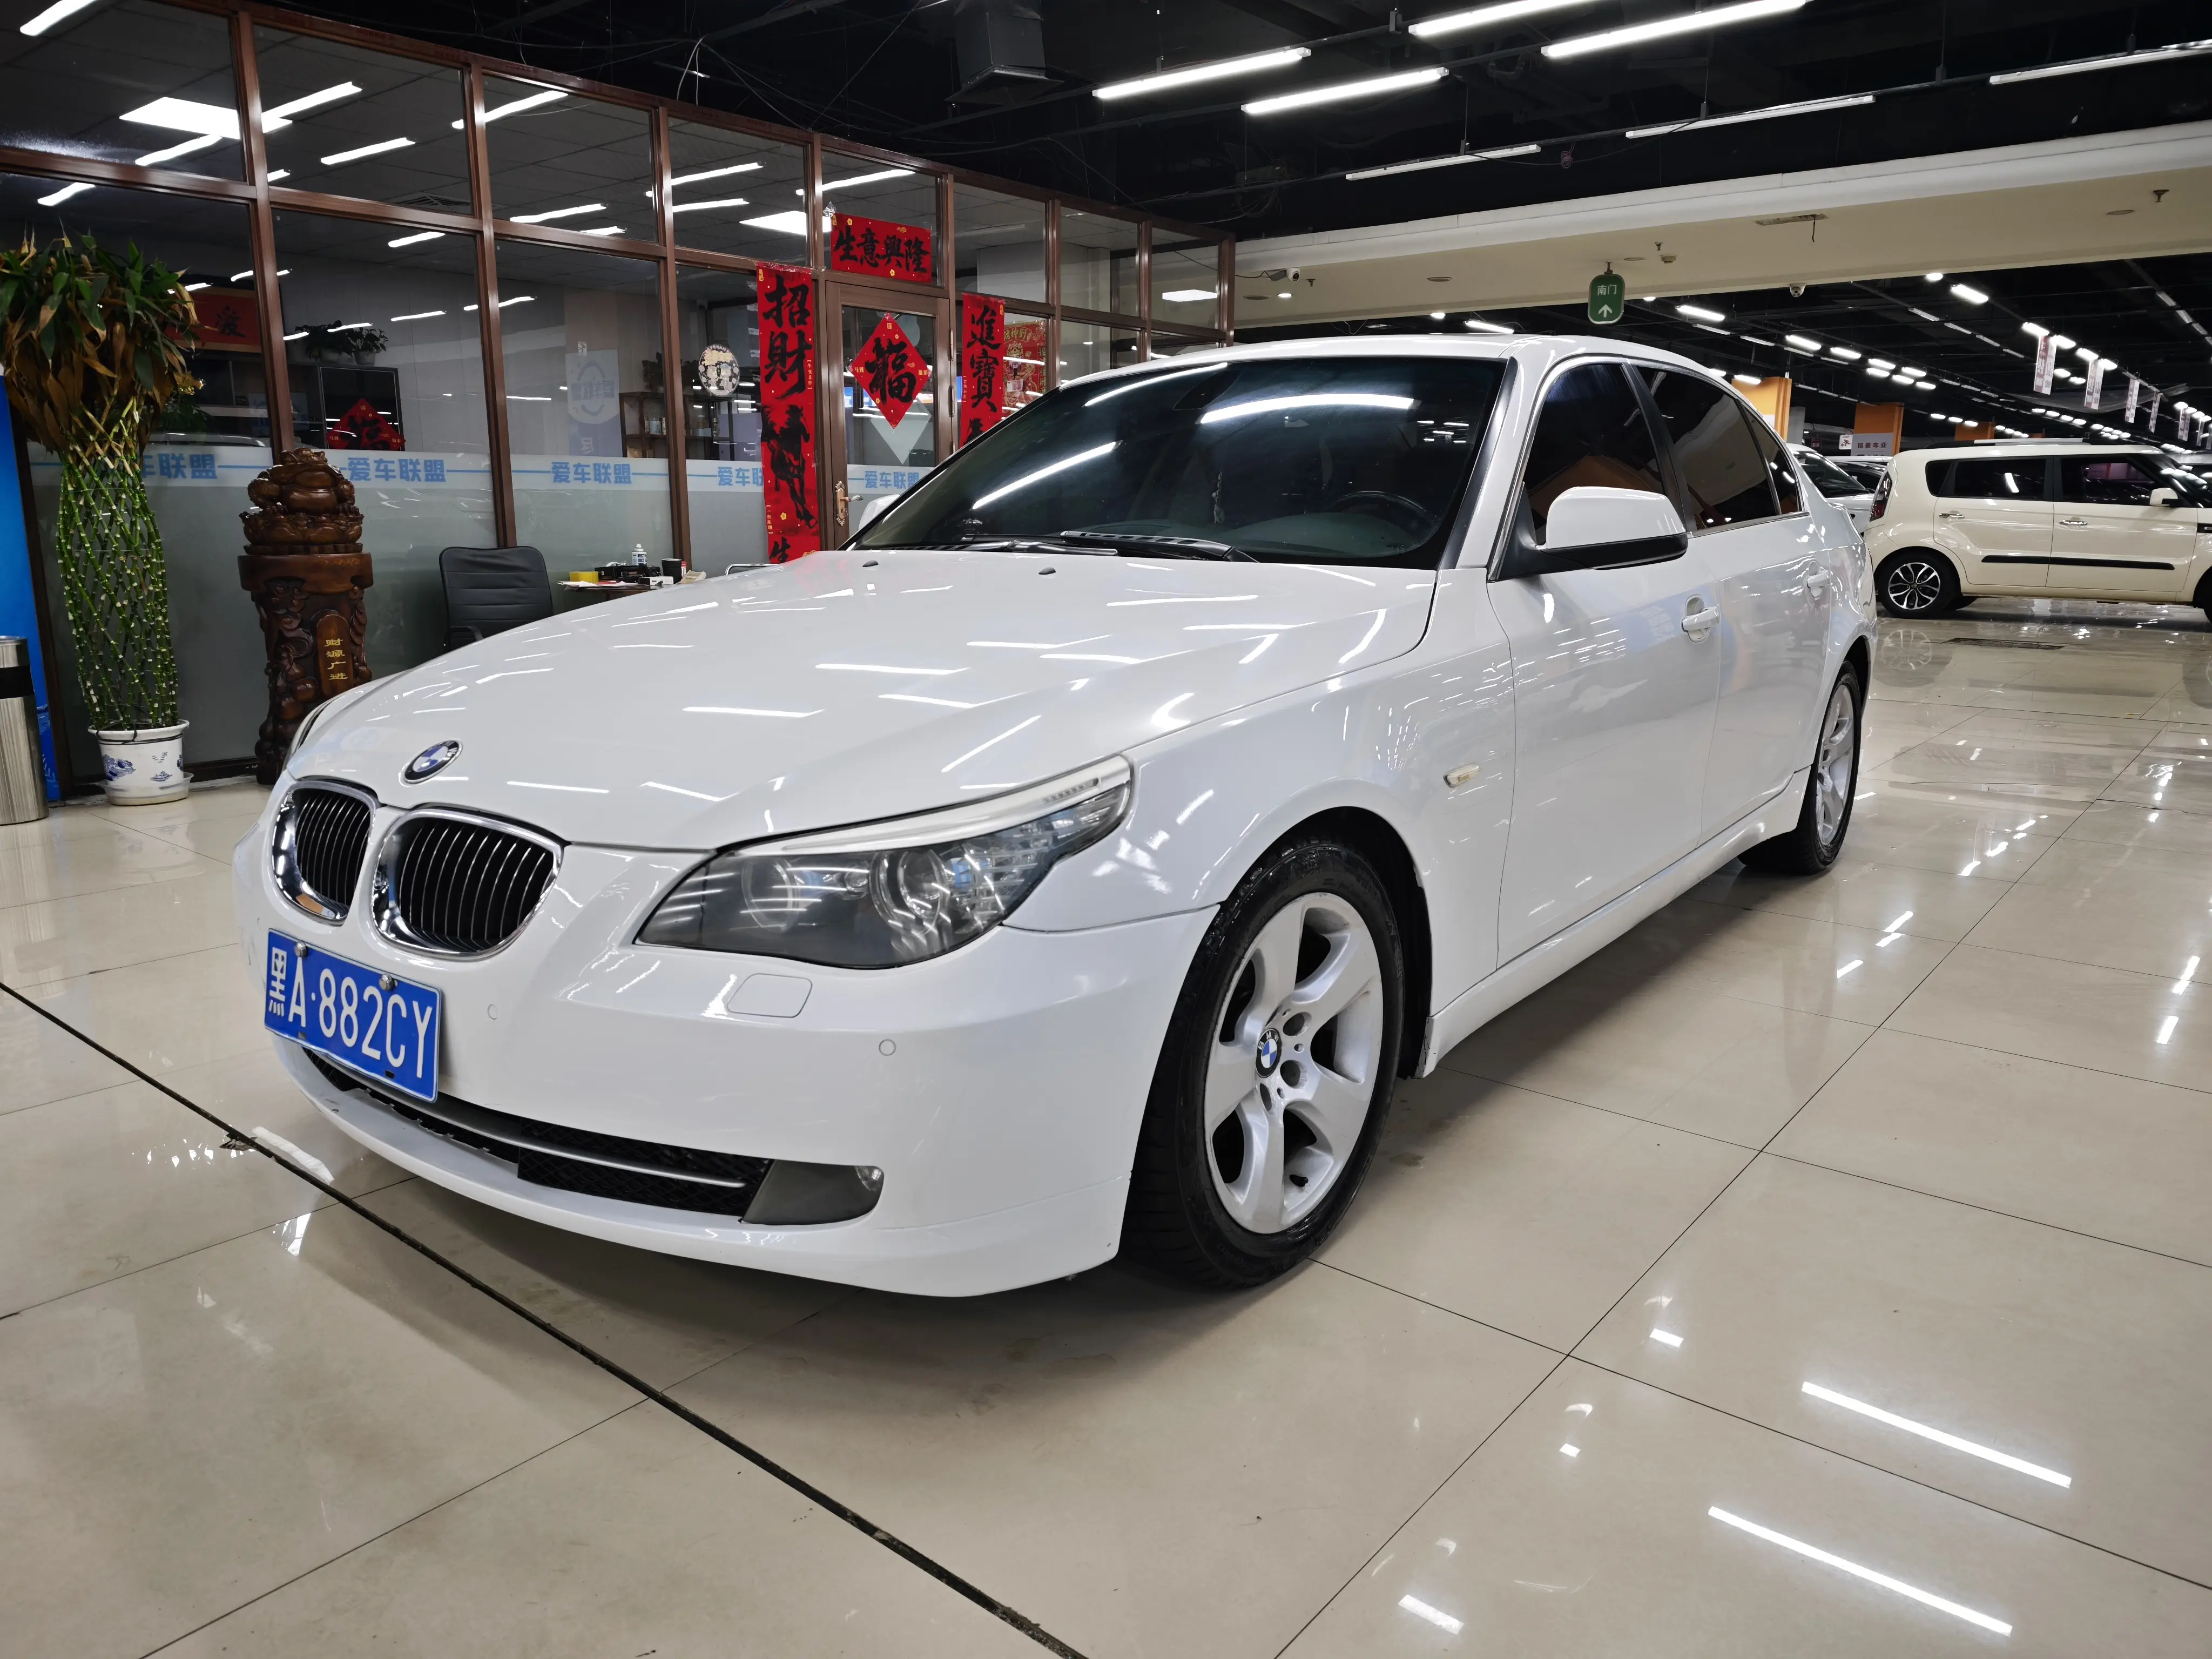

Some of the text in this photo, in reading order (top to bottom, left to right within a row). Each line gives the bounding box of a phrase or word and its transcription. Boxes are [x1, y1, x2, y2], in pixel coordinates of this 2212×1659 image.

[834, 225, 930, 273] 生意興隆
[1597, 284, 1617, 295] 南门
[763, 274, 812, 399] 招財
[865, 337, 916, 405] 福
[967, 305, 1001, 413] 進寶
[348, 457, 446, 482] 爱车联盟
[551, 462, 632, 484] 爱车联盟
[865, 470, 919, 489] 爱车联盟
[325, 638, 348, 680] 财源广进
[1258, 1030, 1279, 1050] BMW
